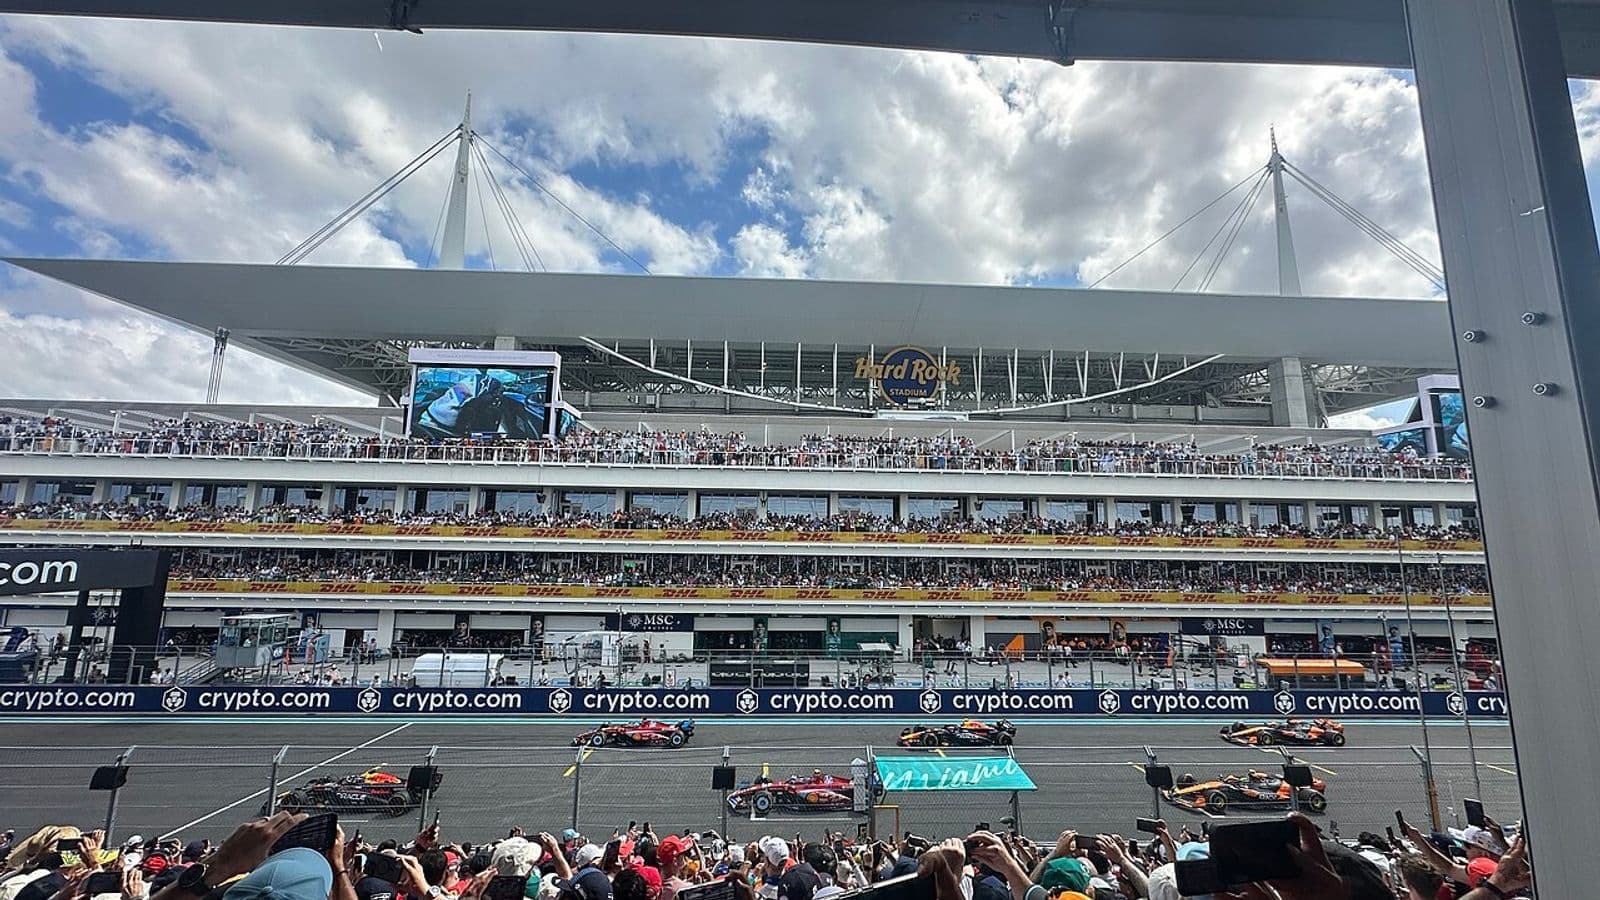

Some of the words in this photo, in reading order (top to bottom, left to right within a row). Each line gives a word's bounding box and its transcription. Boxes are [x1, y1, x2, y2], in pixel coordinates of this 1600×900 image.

[855, 358, 908, 379] Hard
[911, 359, 960, 385] Rock
[890, 388, 928, 397] STADIUM
[47, 521, 85, 529] DHL
[118, 522, 156, 530] DHL
[187, 523, 225, 532] DHL
[258, 524, 296, 533] DHL
[327, 525, 364, 534] DHL
[395, 527, 433, 535] DHL
[463, 528, 501, 536] DHL
[531, 529, 569, 537] DHL
[598, 530, 635, 539] DHL
[665, 531, 702, 540] DHL
[731, 532, 769, 540] DHL
[798, 533, 833, 541] DHL
[863, 534, 898, 542] DHL
[927, 535, 962, 543] DHL
[992, 536, 1026, 544] DHL
[1055, 536, 1090, 544] DHL
[1119, 537, 1153, 545] DHL
[1181, 539, 1215, 547] DHL
[1243, 539, 1277, 547] DHL
[1304, 540, 1338, 548] DHL
[1366, 541, 1400, 549] DHL
[179, 583, 217, 591] DHL
[250, 583, 288, 592] DHL
[320, 584, 357, 592] DHL
[389, 585, 428, 594] DHL
[458, 586, 496, 595] DHL
[527, 587, 565, 596] DHL
[595, 588, 632, 597] DHL
[663, 589, 699, 597] DHL
[729, 589, 766, 598] DHL
[796, 590, 833, 599] DHL
[862, 591, 898, 599] DHL
[927, 591, 962, 600] DHL
[992, 592, 1026, 600] DHL
[1056, 593, 1090, 601] DHL
[1119, 593, 1154, 601] DHL
[1183, 594, 1217, 602] DHL
[1245, 595, 1279, 603] DHL
[1307, 596, 1342, 604] DHL
[1369, 596, 1403, 604] DHL
[644, 614, 674, 625] MSC
[1217, 618, 1245, 629] MSC
[1, 688, 135, 710] crypto.com
[199, 688, 330, 711] crypto.com
[392, 689, 521, 711] crypto.com
[584, 689, 710, 712] crypto.com
[770, 689, 893, 712] crypto.com
[952, 690, 1073, 713] crypto.com
[1131, 690, 1249, 714] crypto.com
[1306, 691, 1420, 714] crypto.com
[883, 762, 1018, 790] Miami
